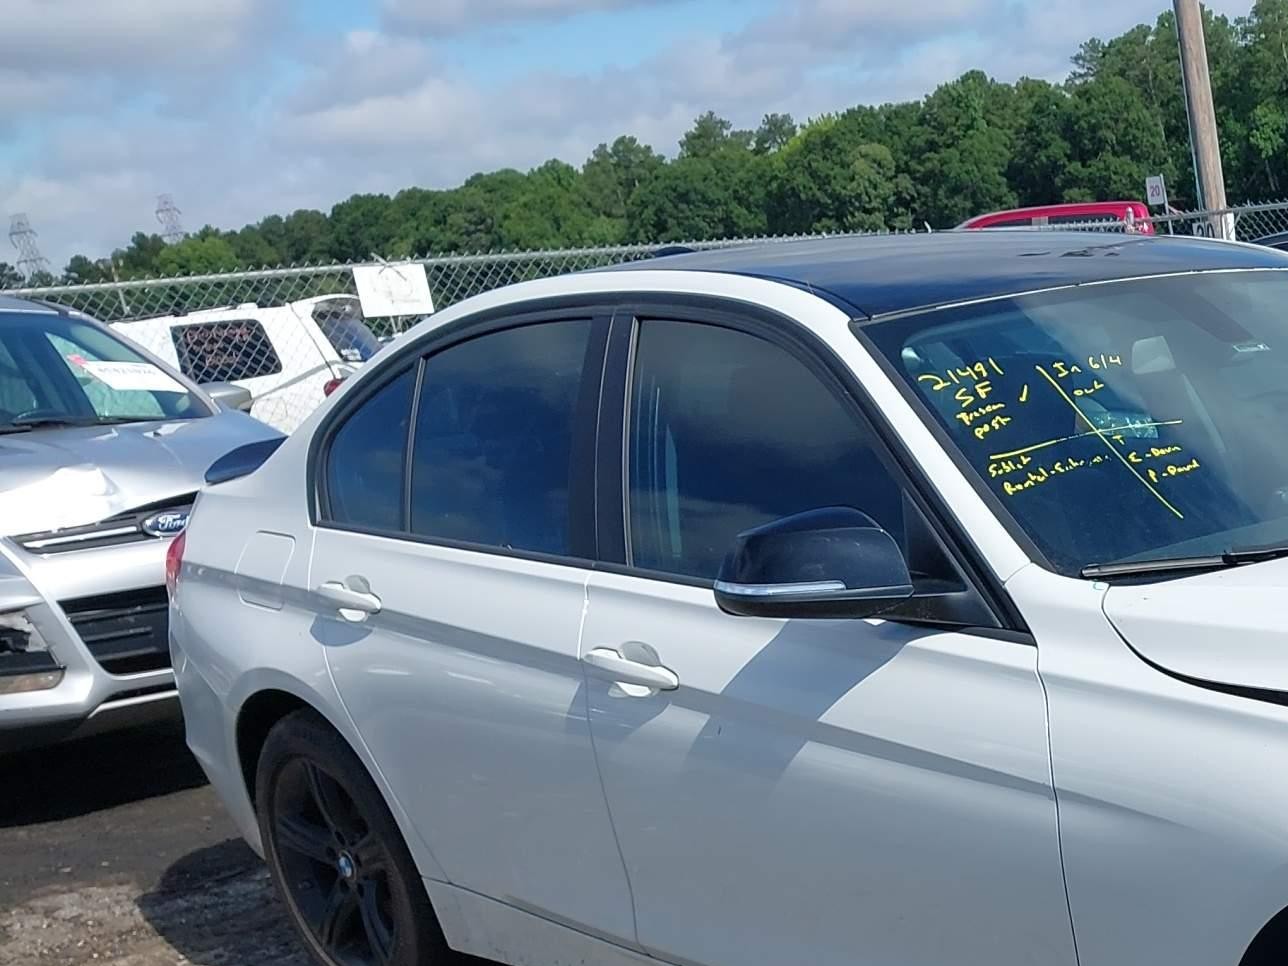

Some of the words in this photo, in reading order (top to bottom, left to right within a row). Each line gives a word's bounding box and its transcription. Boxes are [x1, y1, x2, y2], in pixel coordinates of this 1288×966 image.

[1150, 185, 1160, 197] 20
[917, 356, 1005, 391] 21491
[1052, 361, 1082, 378] In
[954, 380, 993, 408] SF
